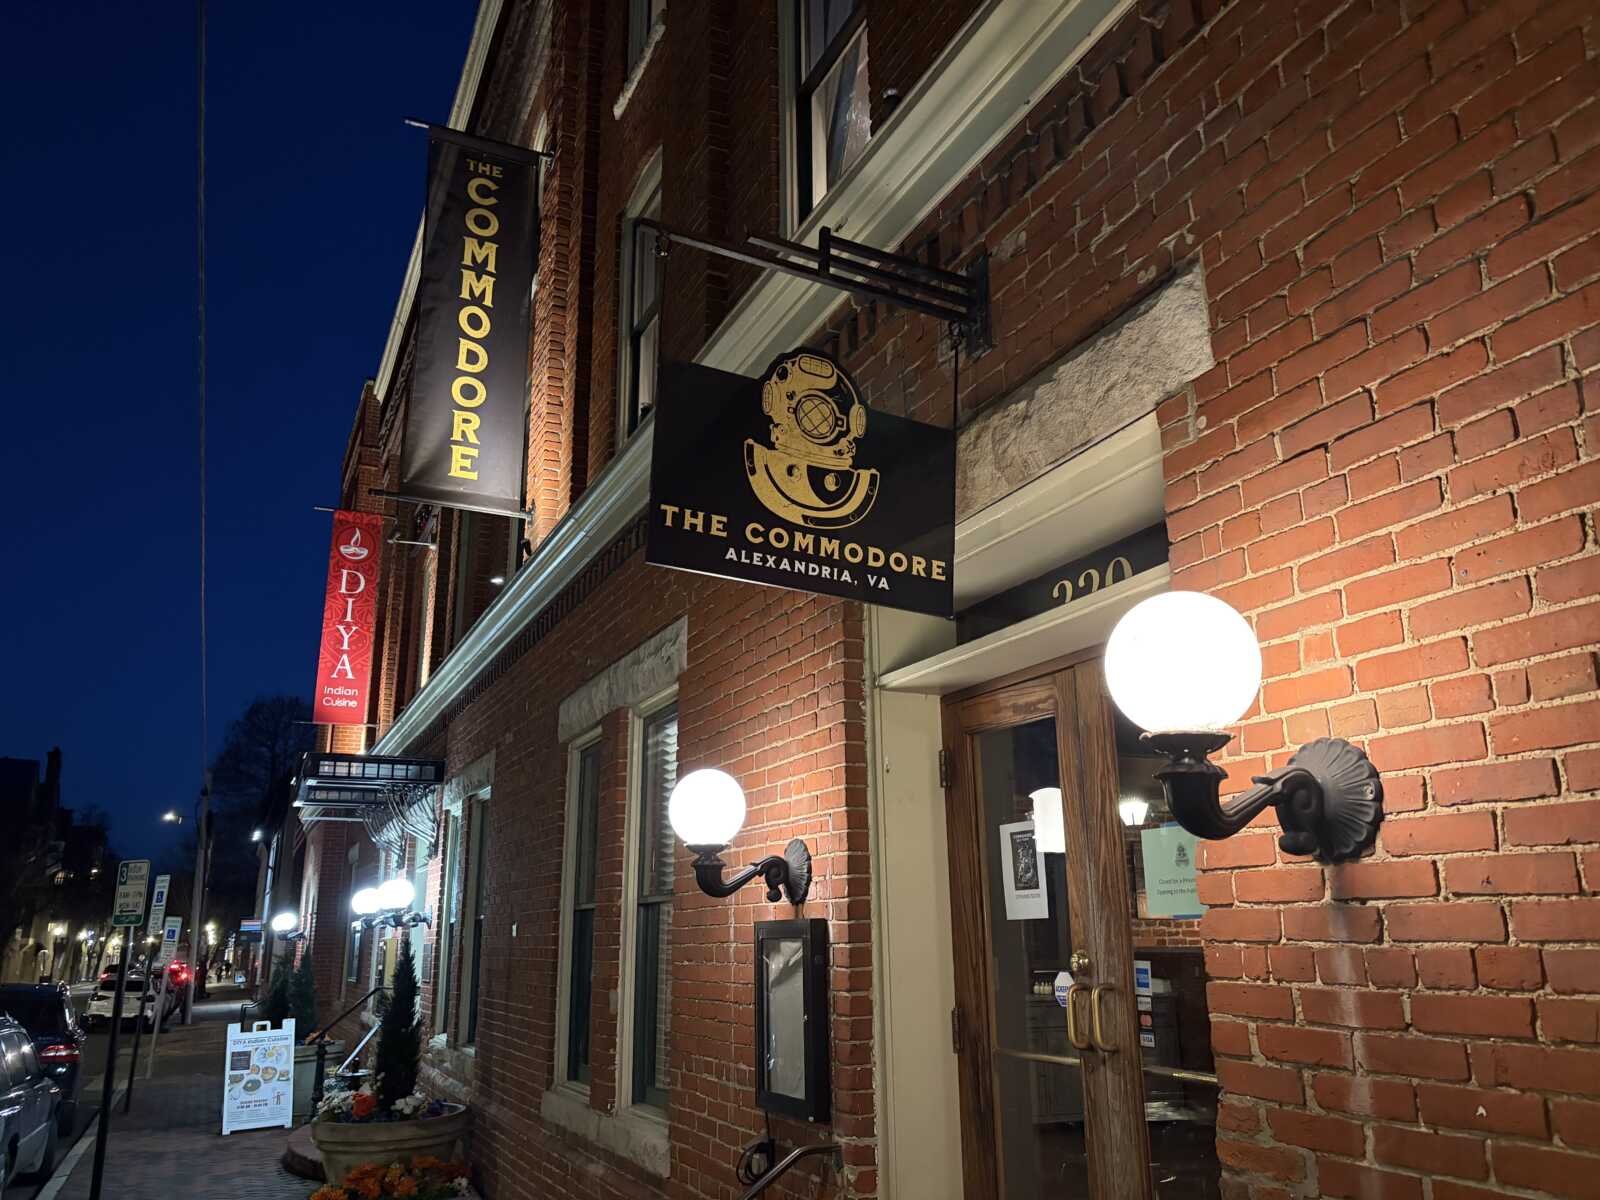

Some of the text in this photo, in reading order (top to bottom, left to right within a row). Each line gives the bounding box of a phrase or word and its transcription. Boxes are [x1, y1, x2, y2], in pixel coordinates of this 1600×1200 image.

[466, 158, 504, 178] THE
[448, 178, 500, 481] COMMODORE
[660, 504, 947, 581] THE COMMODORE
[725, 547, 890, 590] ALEXANDRIA, VA
[331, 568, 366, 680] DIYA
[322, 697, 358, 708] Cuisine
[324, 686, 359, 697] Indian
[120, 867, 127, 882] 3
